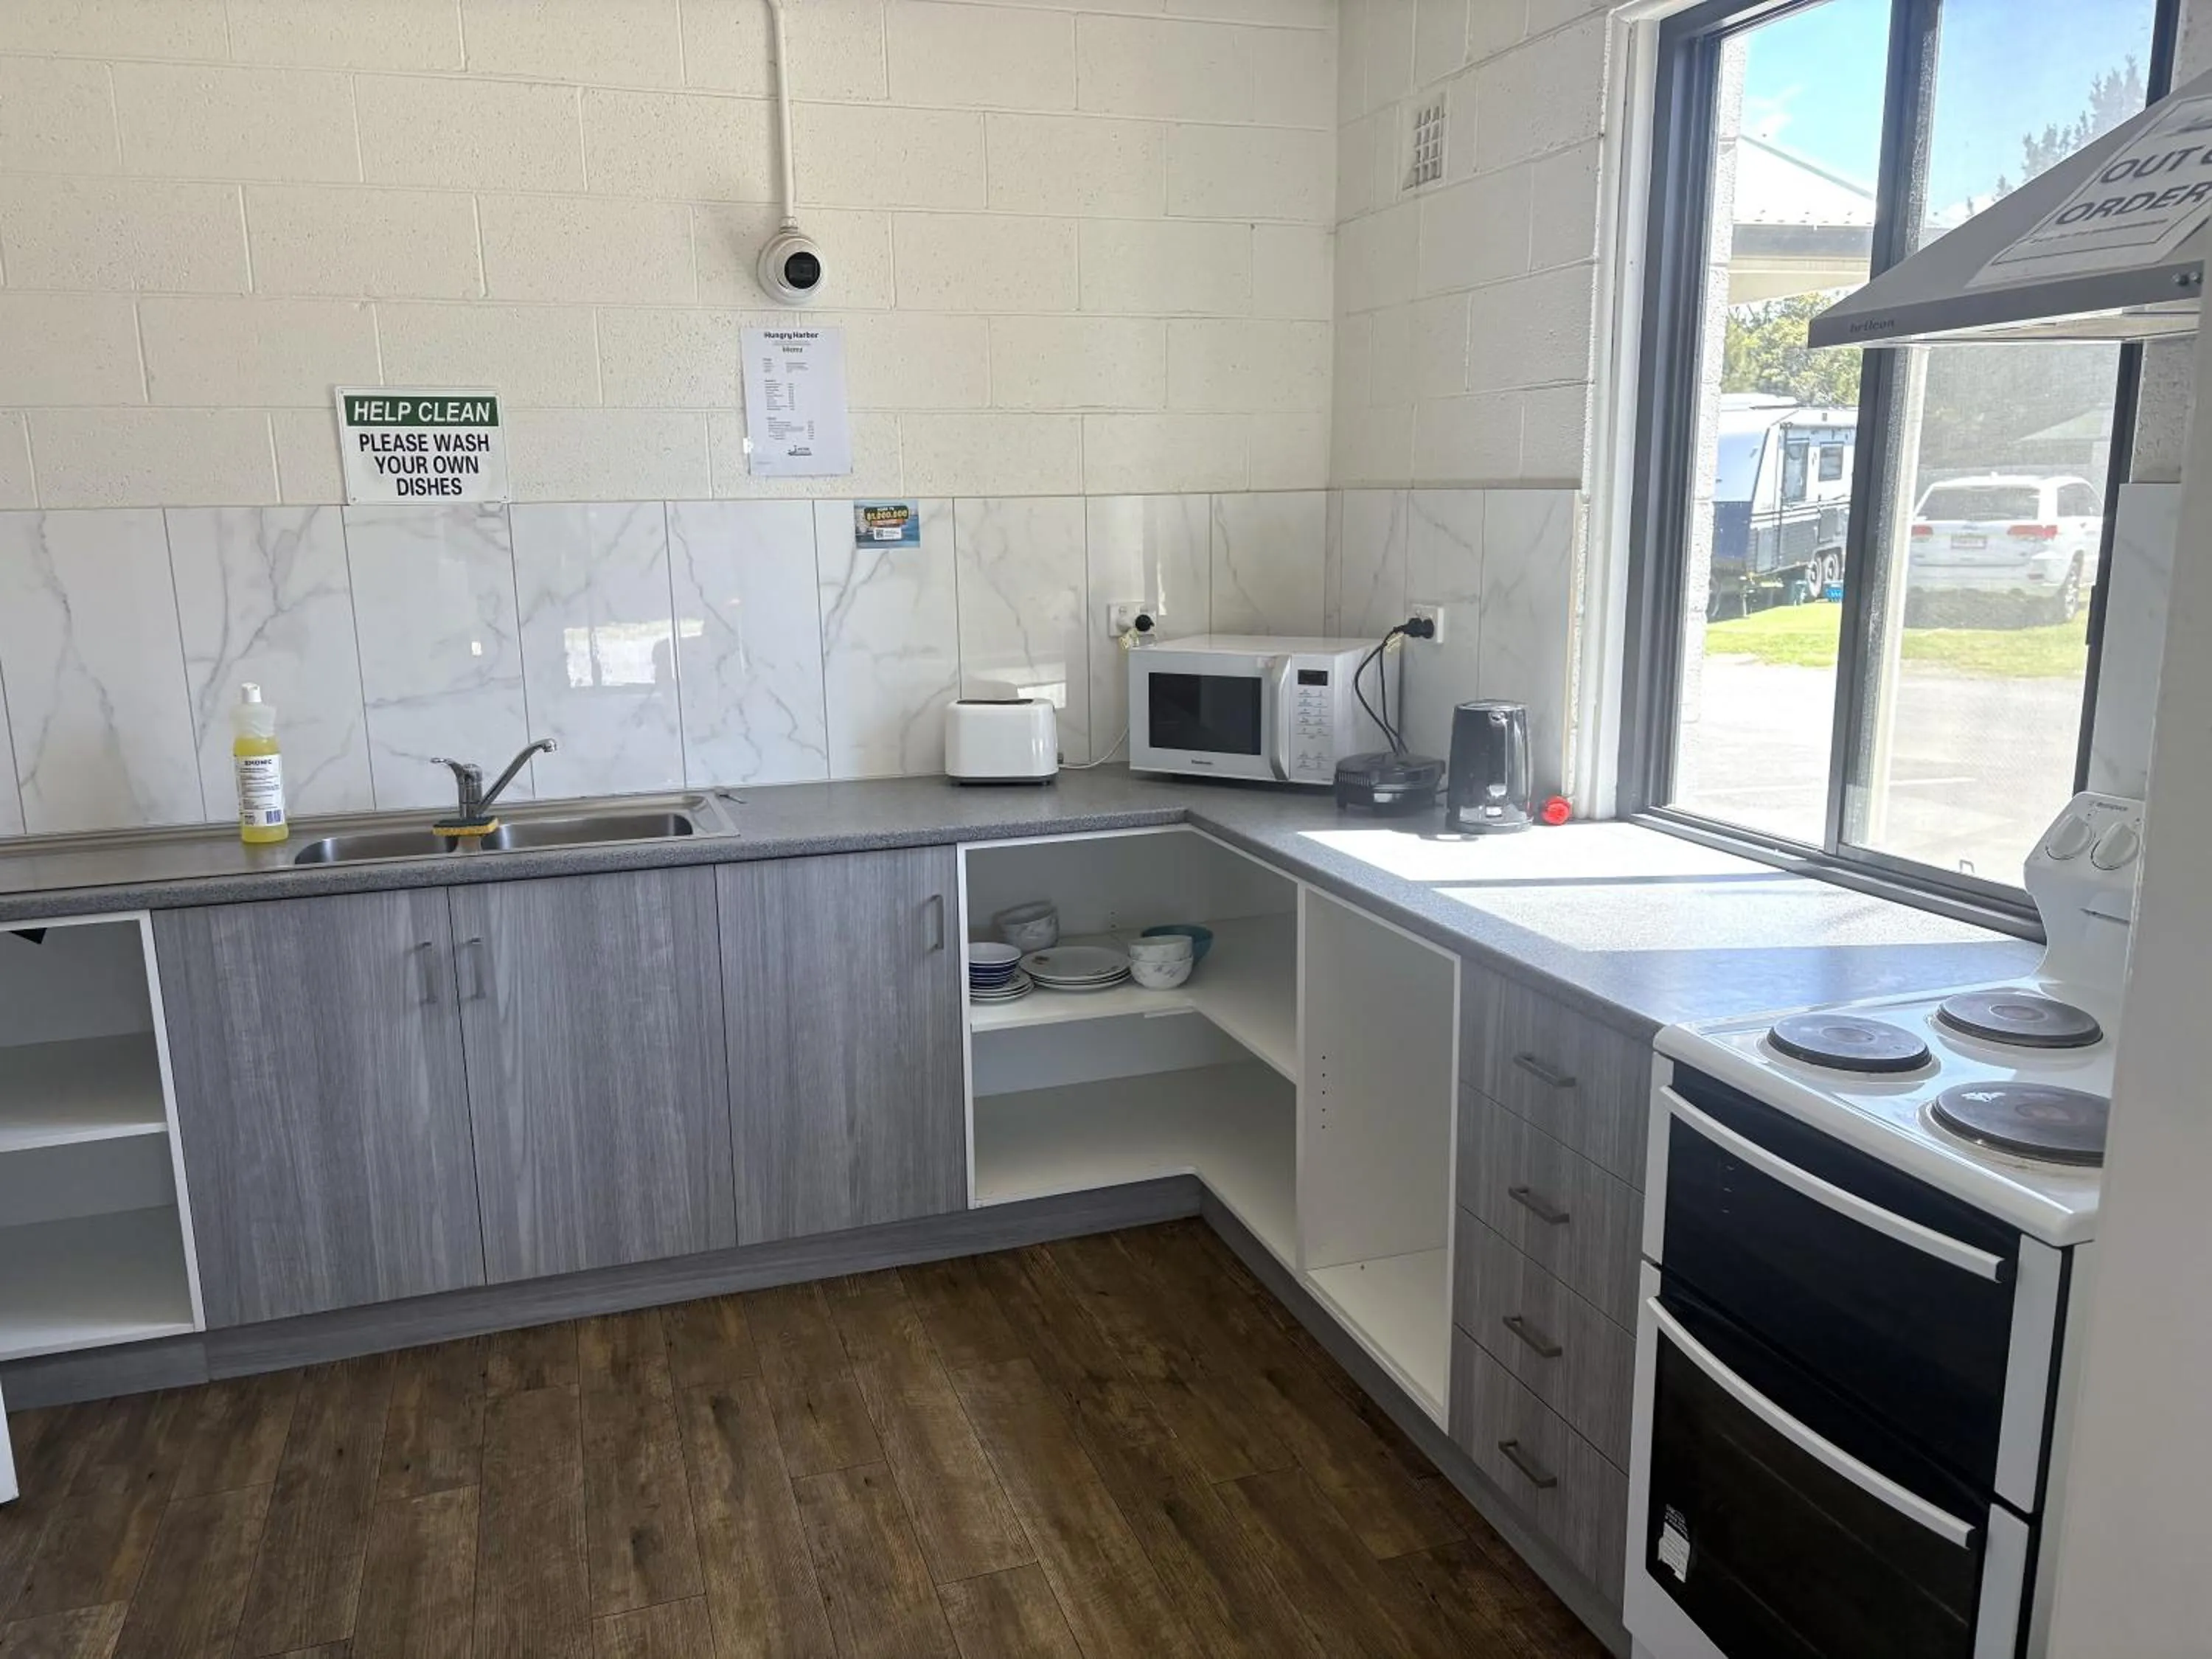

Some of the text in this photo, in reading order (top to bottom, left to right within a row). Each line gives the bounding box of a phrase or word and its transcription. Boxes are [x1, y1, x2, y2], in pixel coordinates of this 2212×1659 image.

[2100, 145, 2206, 183] OUT
[2056, 181, 2212, 225] ORDER
[353, 400, 490, 422] HELP CLEAN
[359, 434, 490, 452] PLEASE WASH
[375, 456, 479, 474] YOUR OWN
[397, 478, 462, 495] DISHES
